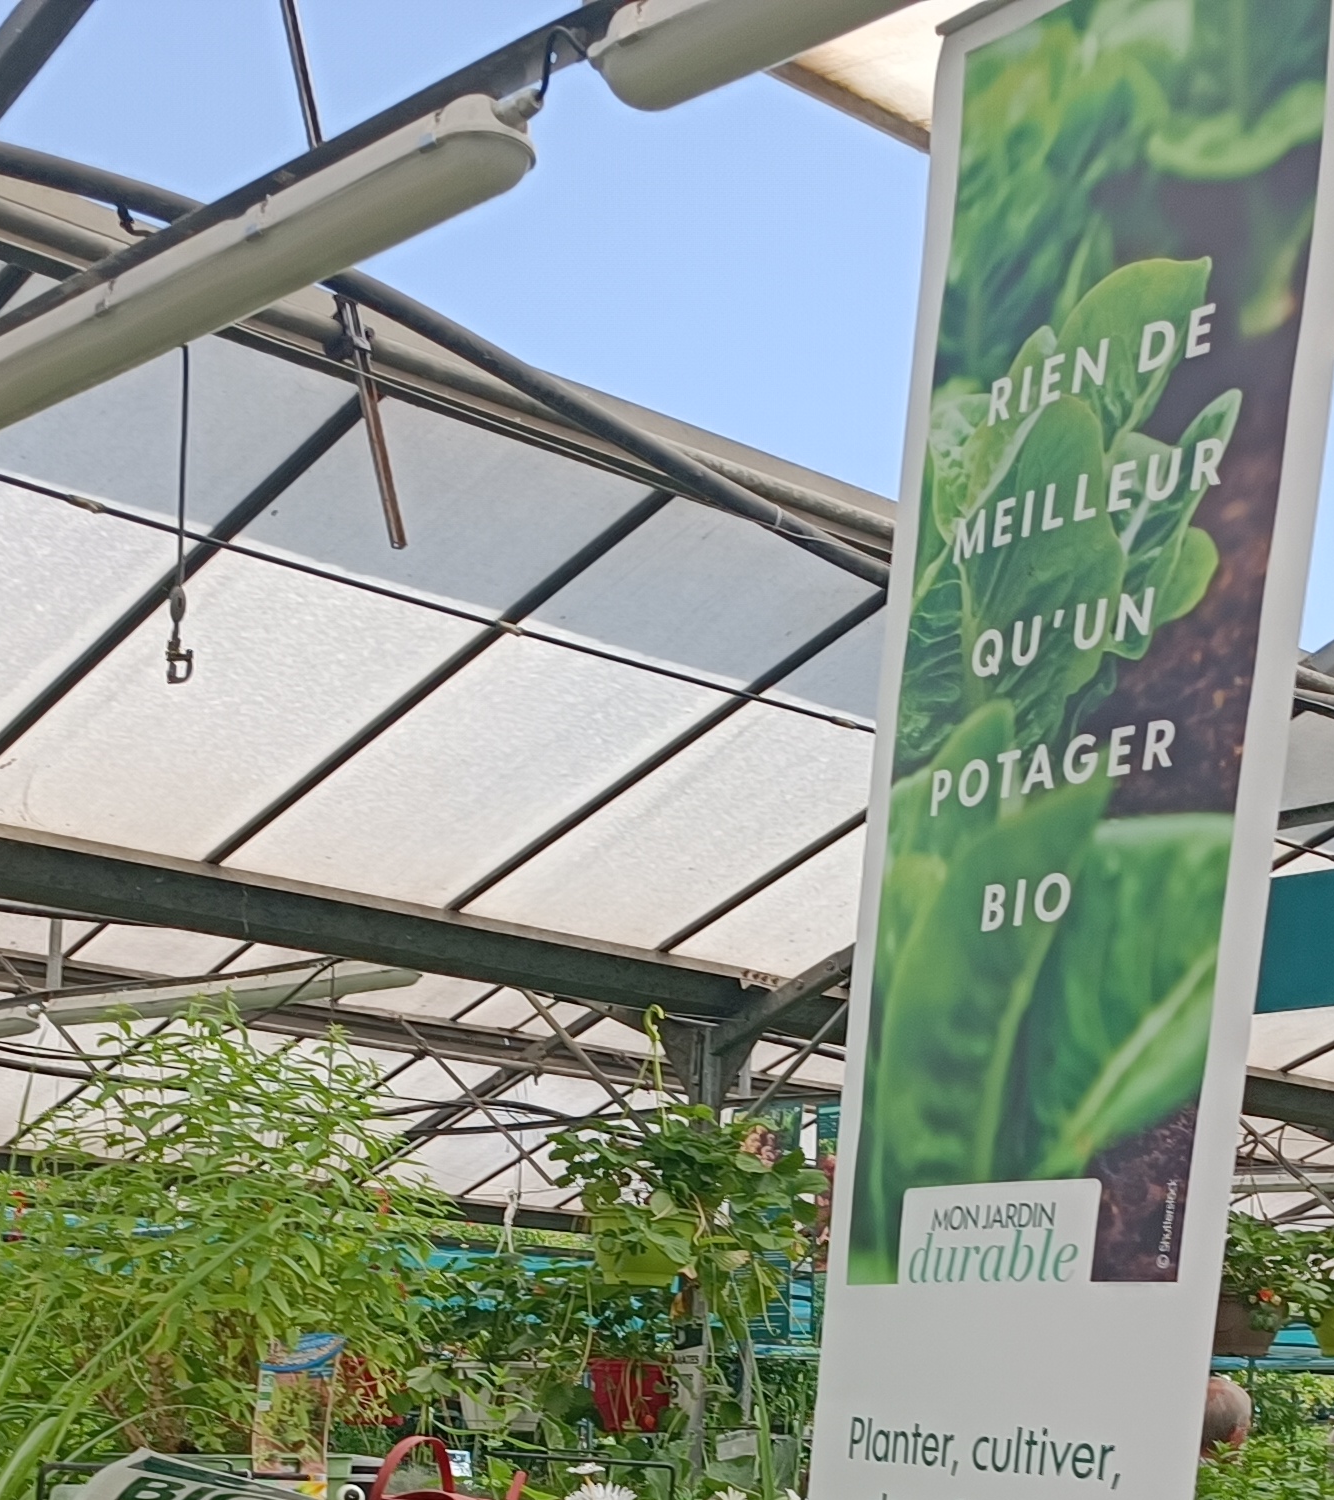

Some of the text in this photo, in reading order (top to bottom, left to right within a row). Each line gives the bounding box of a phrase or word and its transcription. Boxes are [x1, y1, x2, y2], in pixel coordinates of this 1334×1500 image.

[987, 303, 1216, 427] RIEN DE
[952, 437, 1221, 564] MEILLEUR
[930, 720, 1176, 816] POTAGER
[981, 872, 1071, 932] BIO
[931, 1202, 1056, 1231] MON JARDIN
[908, 1228, 1079, 1284] durable
[848, 1416, 1121, 1490] Planter, cultiver,
